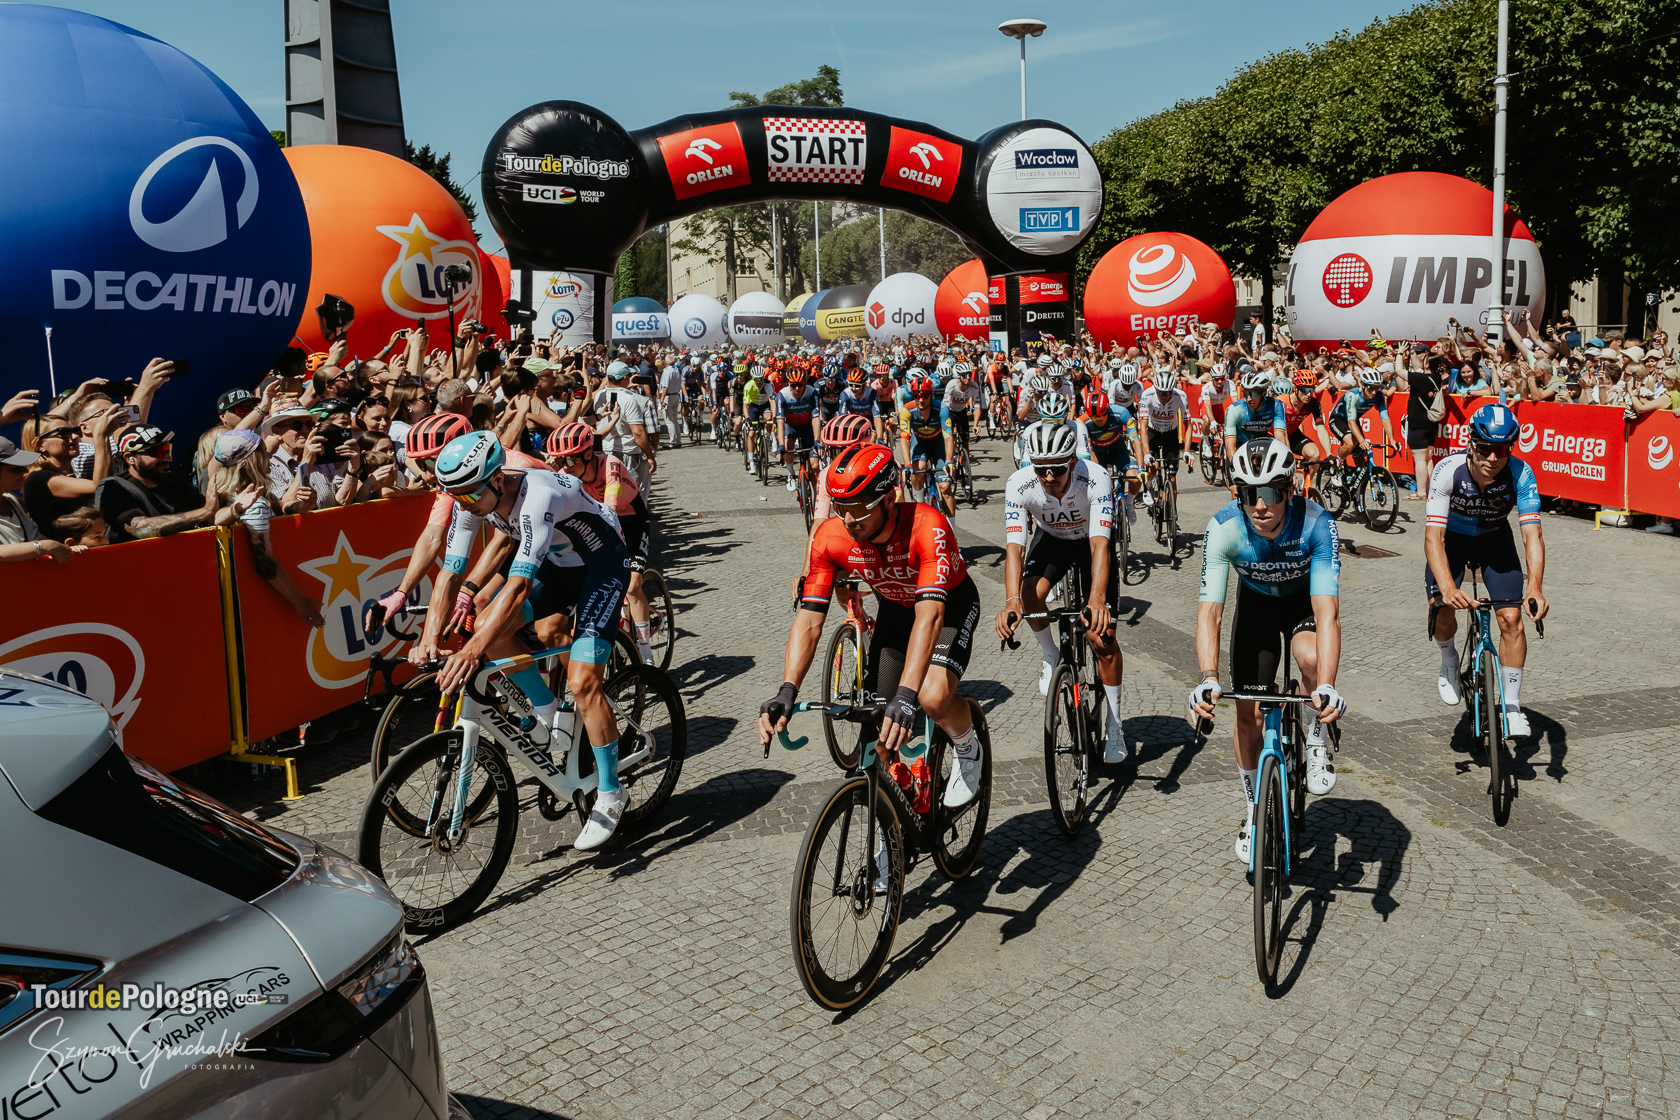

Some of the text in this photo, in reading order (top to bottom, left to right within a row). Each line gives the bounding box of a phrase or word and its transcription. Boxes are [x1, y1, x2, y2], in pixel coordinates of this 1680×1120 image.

[770, 134, 865, 166] START
[1018, 150, 1076, 166] Wrocław
[504, 153, 629, 179] TourdePologne
[687, 164, 734, 186] ORLEN
[1048, 169, 1077, 177] spotkań
[899, 166, 943, 189] ORLEN
[527, 187, 557, 201] UCI
[580, 190, 605, 198] WORLD
[1027, 209, 1073, 228] TVP 1
[552, 284, 576, 295] LOTTO
[1385, 256, 1531, 307] IMPEL
[51, 269, 297, 317] DECATHLON
[615, 314, 660, 335] quest
[828, 316, 866, 325] LANGTE
[891, 307, 925, 328] dpd
[1037, 311, 1065, 320] DRUTEX
[1130, 314, 1199, 331] Energa
[735, 324, 781, 336] Chroma
[1542, 428, 1607, 462] Energa
[1541, 460, 1571, 475] GRUPA
[1573, 464, 1604, 479] ORLEN
[1450, 494, 1487, 507] ISRAEL
[1042, 509, 1083, 523] UAE
[522, 514, 533, 557] MERIDA
[564, 518, 604, 553] BAHRAIN
[1327, 519, 1340, 570] MONDIALE
[847, 555, 876, 563] Bianchi
[931, 527, 950, 585] ARKEA
[1250, 555, 1313, 571] DECATHLON
[851, 565, 920, 581] ARKEA
[480, 706, 560, 778] MERIDA
